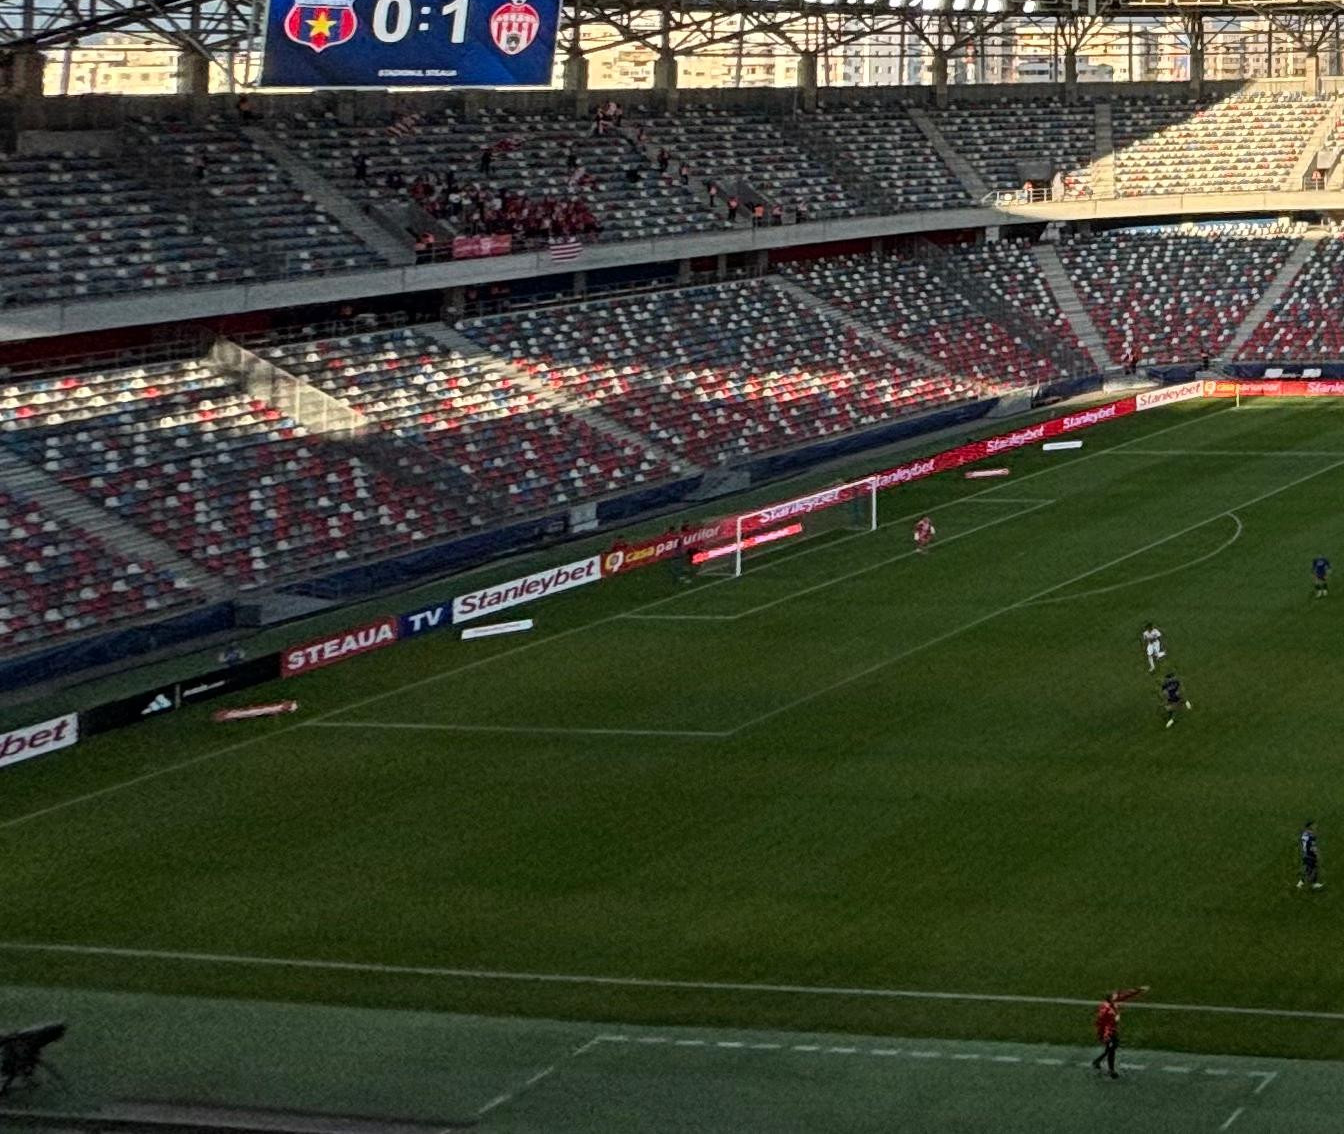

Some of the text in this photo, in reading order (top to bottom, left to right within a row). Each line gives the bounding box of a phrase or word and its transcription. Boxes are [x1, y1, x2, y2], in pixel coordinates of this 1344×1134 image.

[1140, 383, 1201, 406] Stanleybet
[655, 525, 720, 557] parurilor
[458, 559, 596, 615] Stanleybet
[287, 607, 444, 671] STEAUA TV
